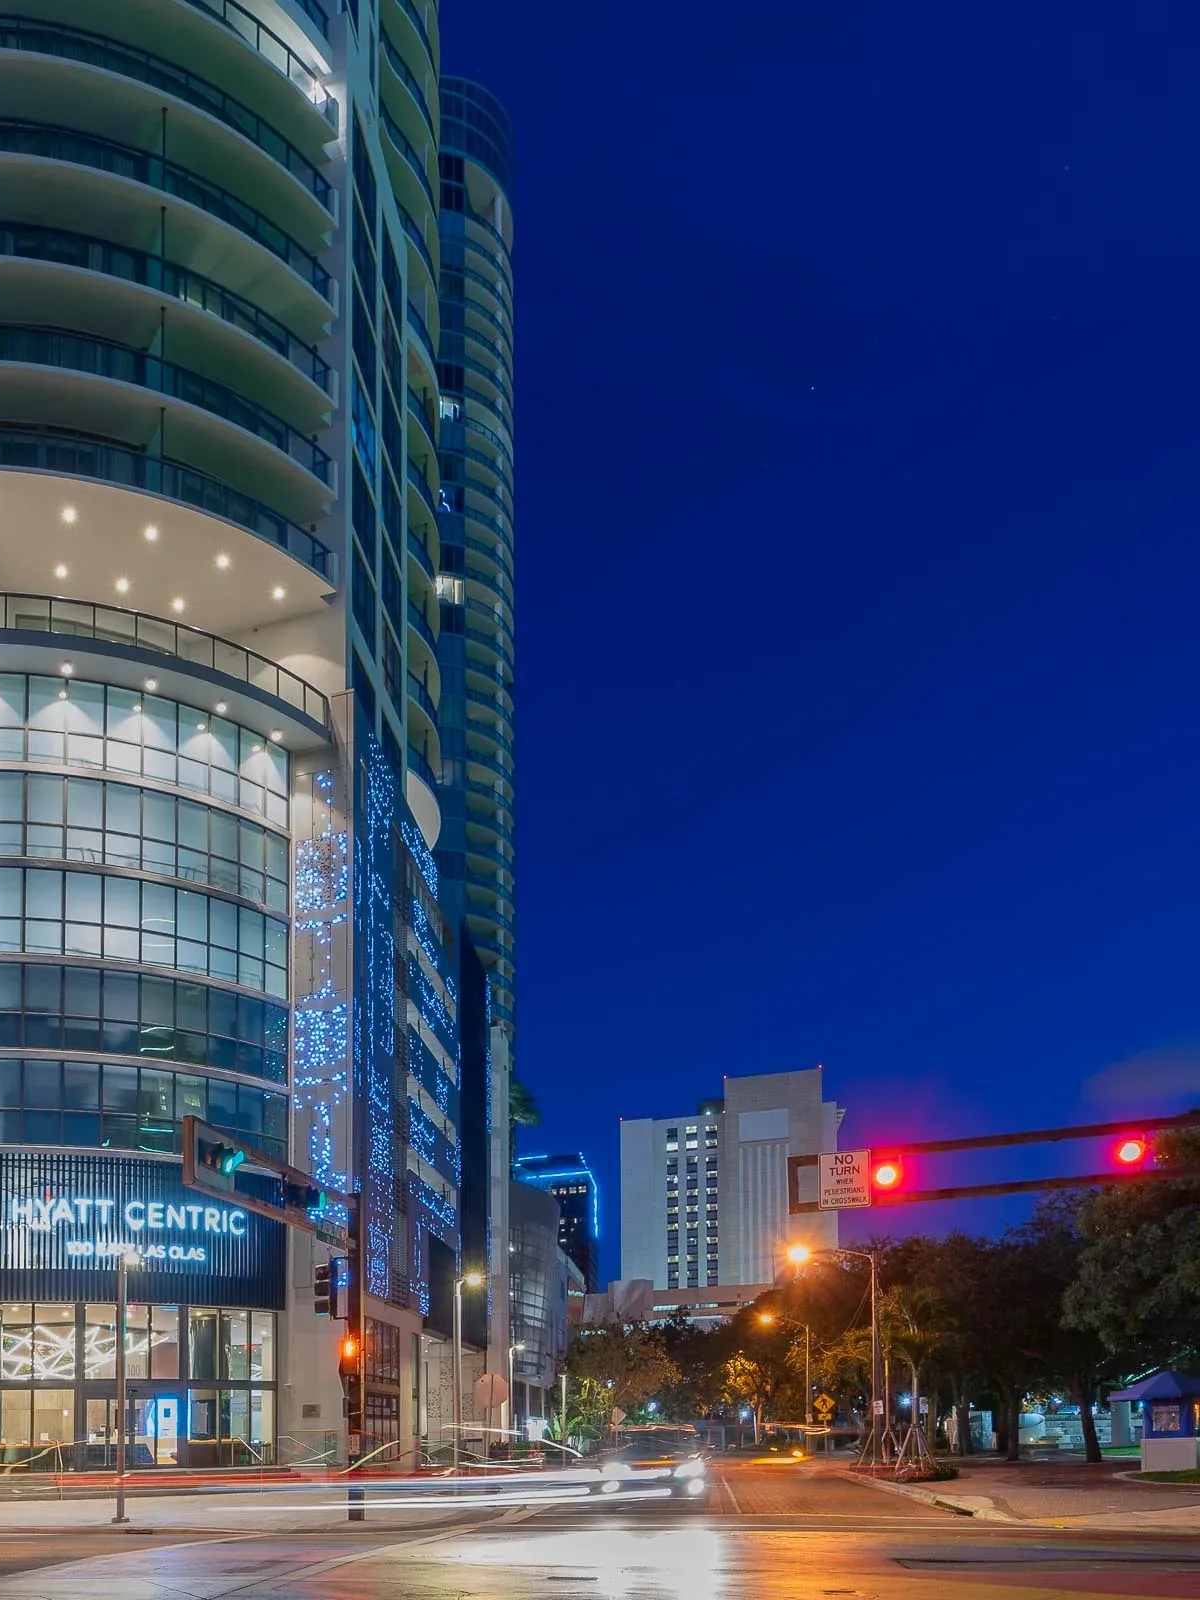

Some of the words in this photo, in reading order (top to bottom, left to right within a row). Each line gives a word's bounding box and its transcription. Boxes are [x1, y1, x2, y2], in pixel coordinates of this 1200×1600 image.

[834, 1154, 854, 1165] NO
[829, 1165, 860, 1176] TURN
[824, 1186, 865, 1196] PEDESTRIANS
[822, 1197, 829, 1205] IN
[831, 1195, 867, 1205] CROSSWALK
[12, 1198, 114, 1226] HYATT
[124, 1200, 246, 1235] CENTRIC
[138, 1244, 166, 1259] LAS
[168, 1245, 206, 1261] OLAS
[127, 1364, 141, 1376] 100
